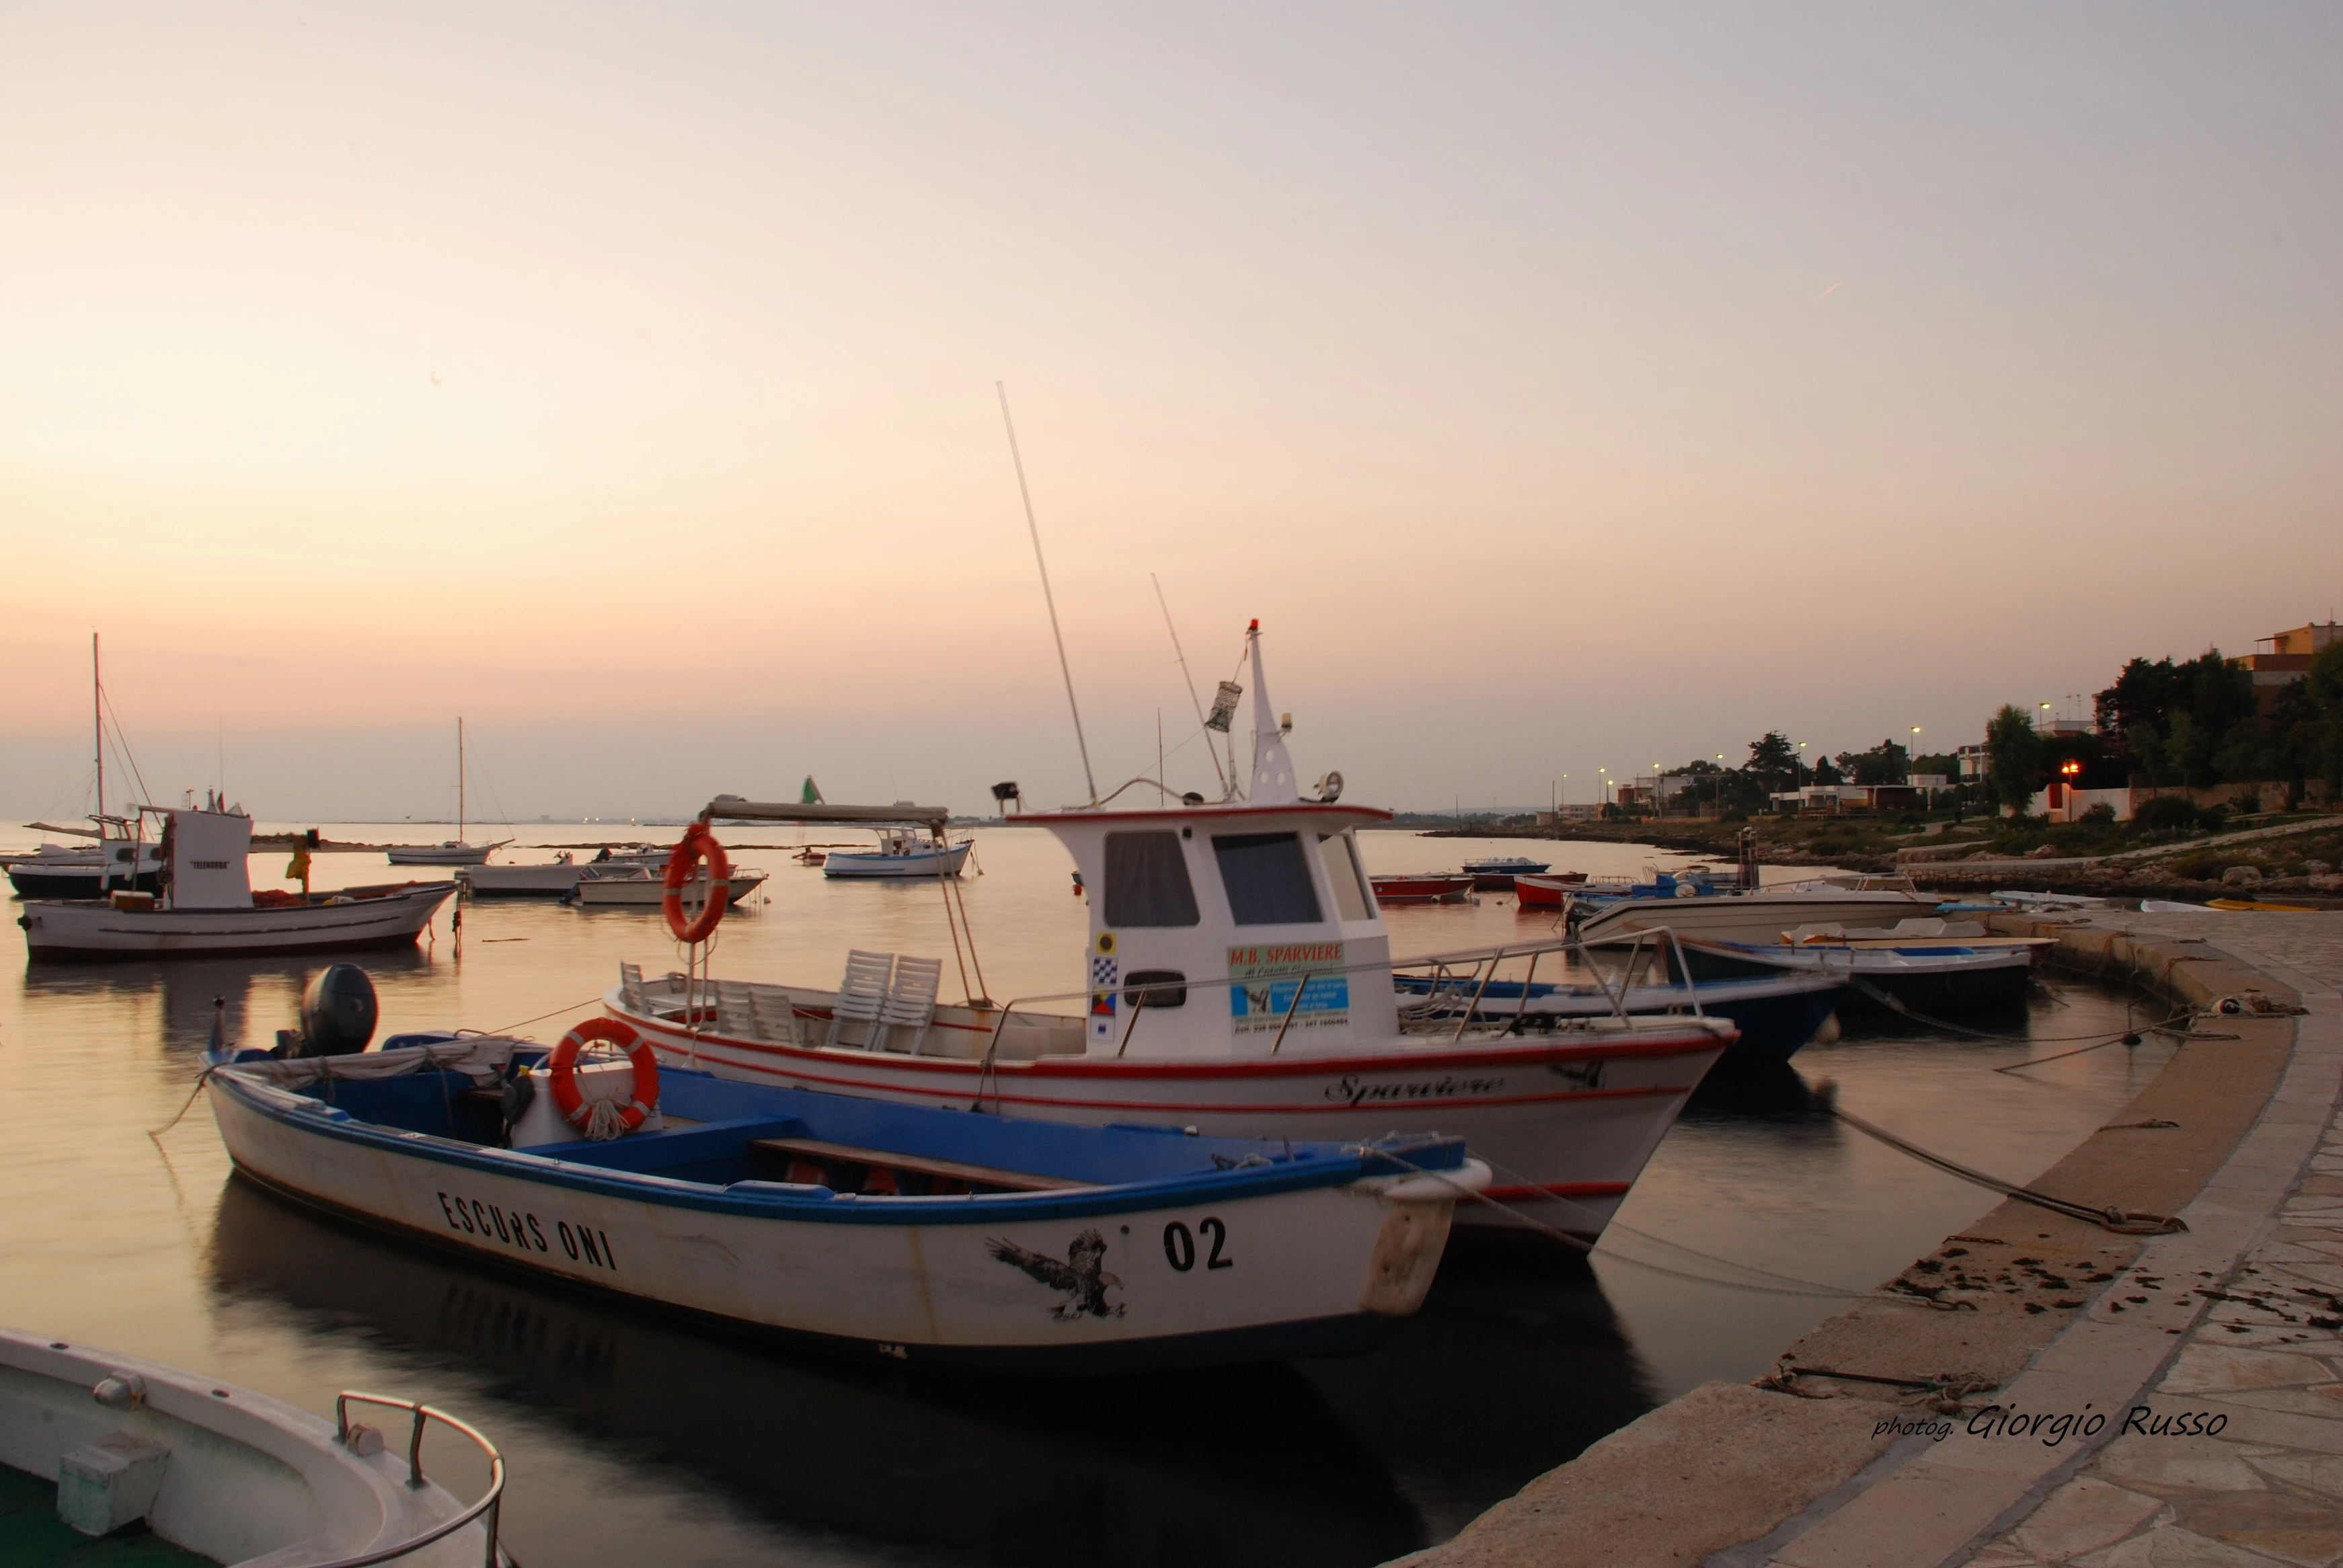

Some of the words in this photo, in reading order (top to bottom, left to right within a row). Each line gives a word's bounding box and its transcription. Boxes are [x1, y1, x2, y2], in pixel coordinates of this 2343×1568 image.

[1230, 947, 1260, 966] M.B.
[1266, 943, 1343, 964] SPARVIERE
[558, 1220, 617, 1271] ONI
[1163, 1216, 1233, 1271] 02
